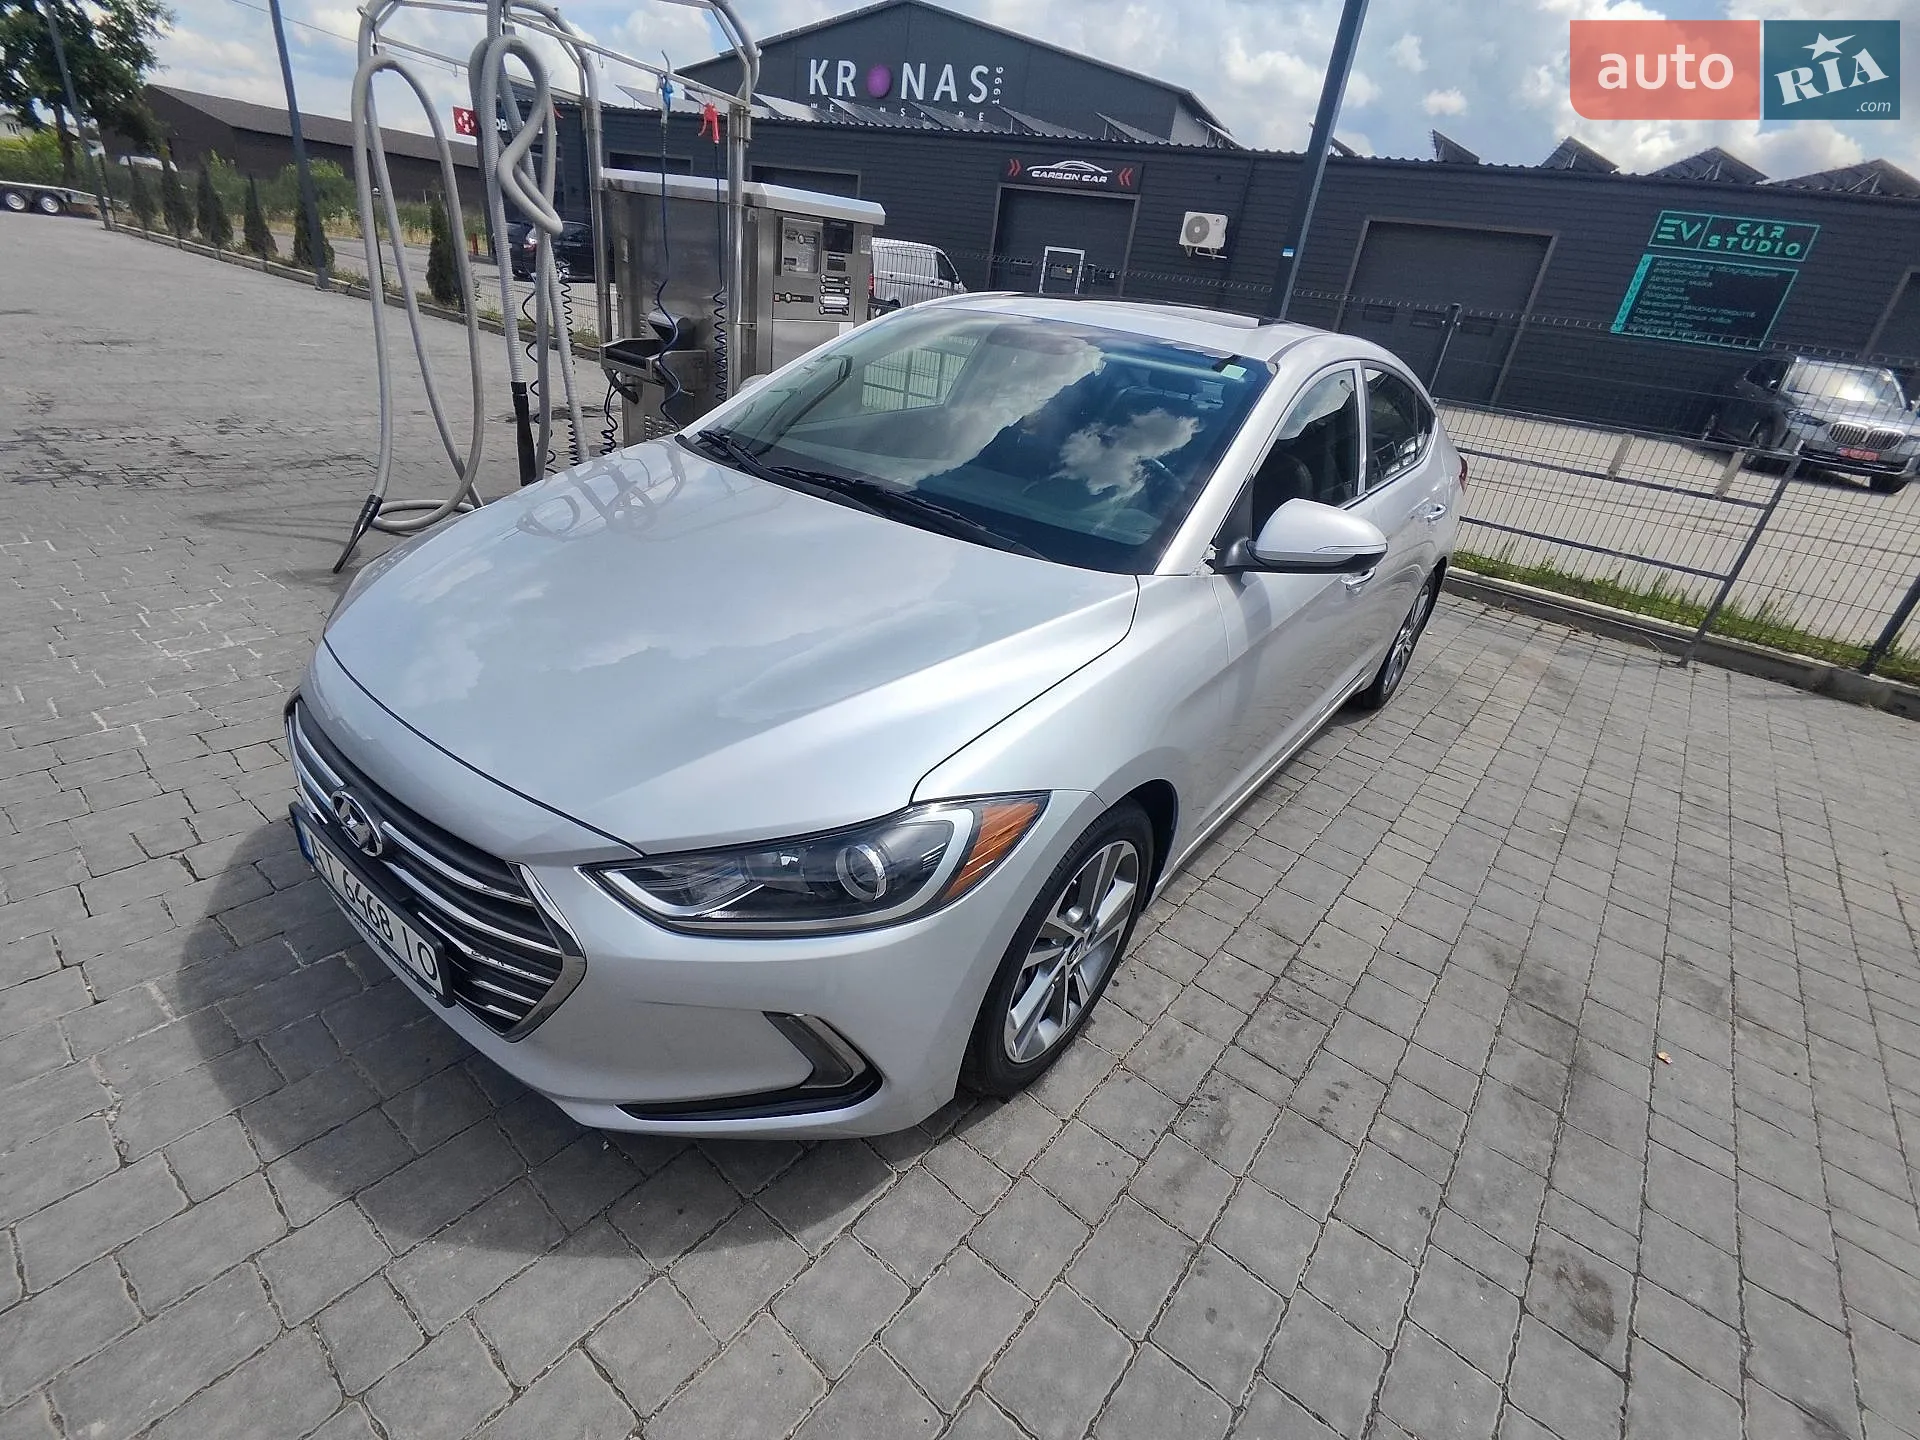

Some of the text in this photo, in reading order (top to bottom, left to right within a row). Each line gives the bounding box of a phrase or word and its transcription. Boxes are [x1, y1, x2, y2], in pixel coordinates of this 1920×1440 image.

[809, 58, 990, 104] KRONAS
[991, 66, 1004, 105] 1996
[1031, 170, 1081, 181] CARBON
[1081, 174, 1108, 183] CAR
[1657, 219, 1702, 241] EV
[1736, 222, 1786, 239] CAR
[1707, 235, 1801, 256] STUDIO
[310, 834, 337, 884] AT
[342, 868, 394, 942] 6468
[401, 925, 438, 981] IO
